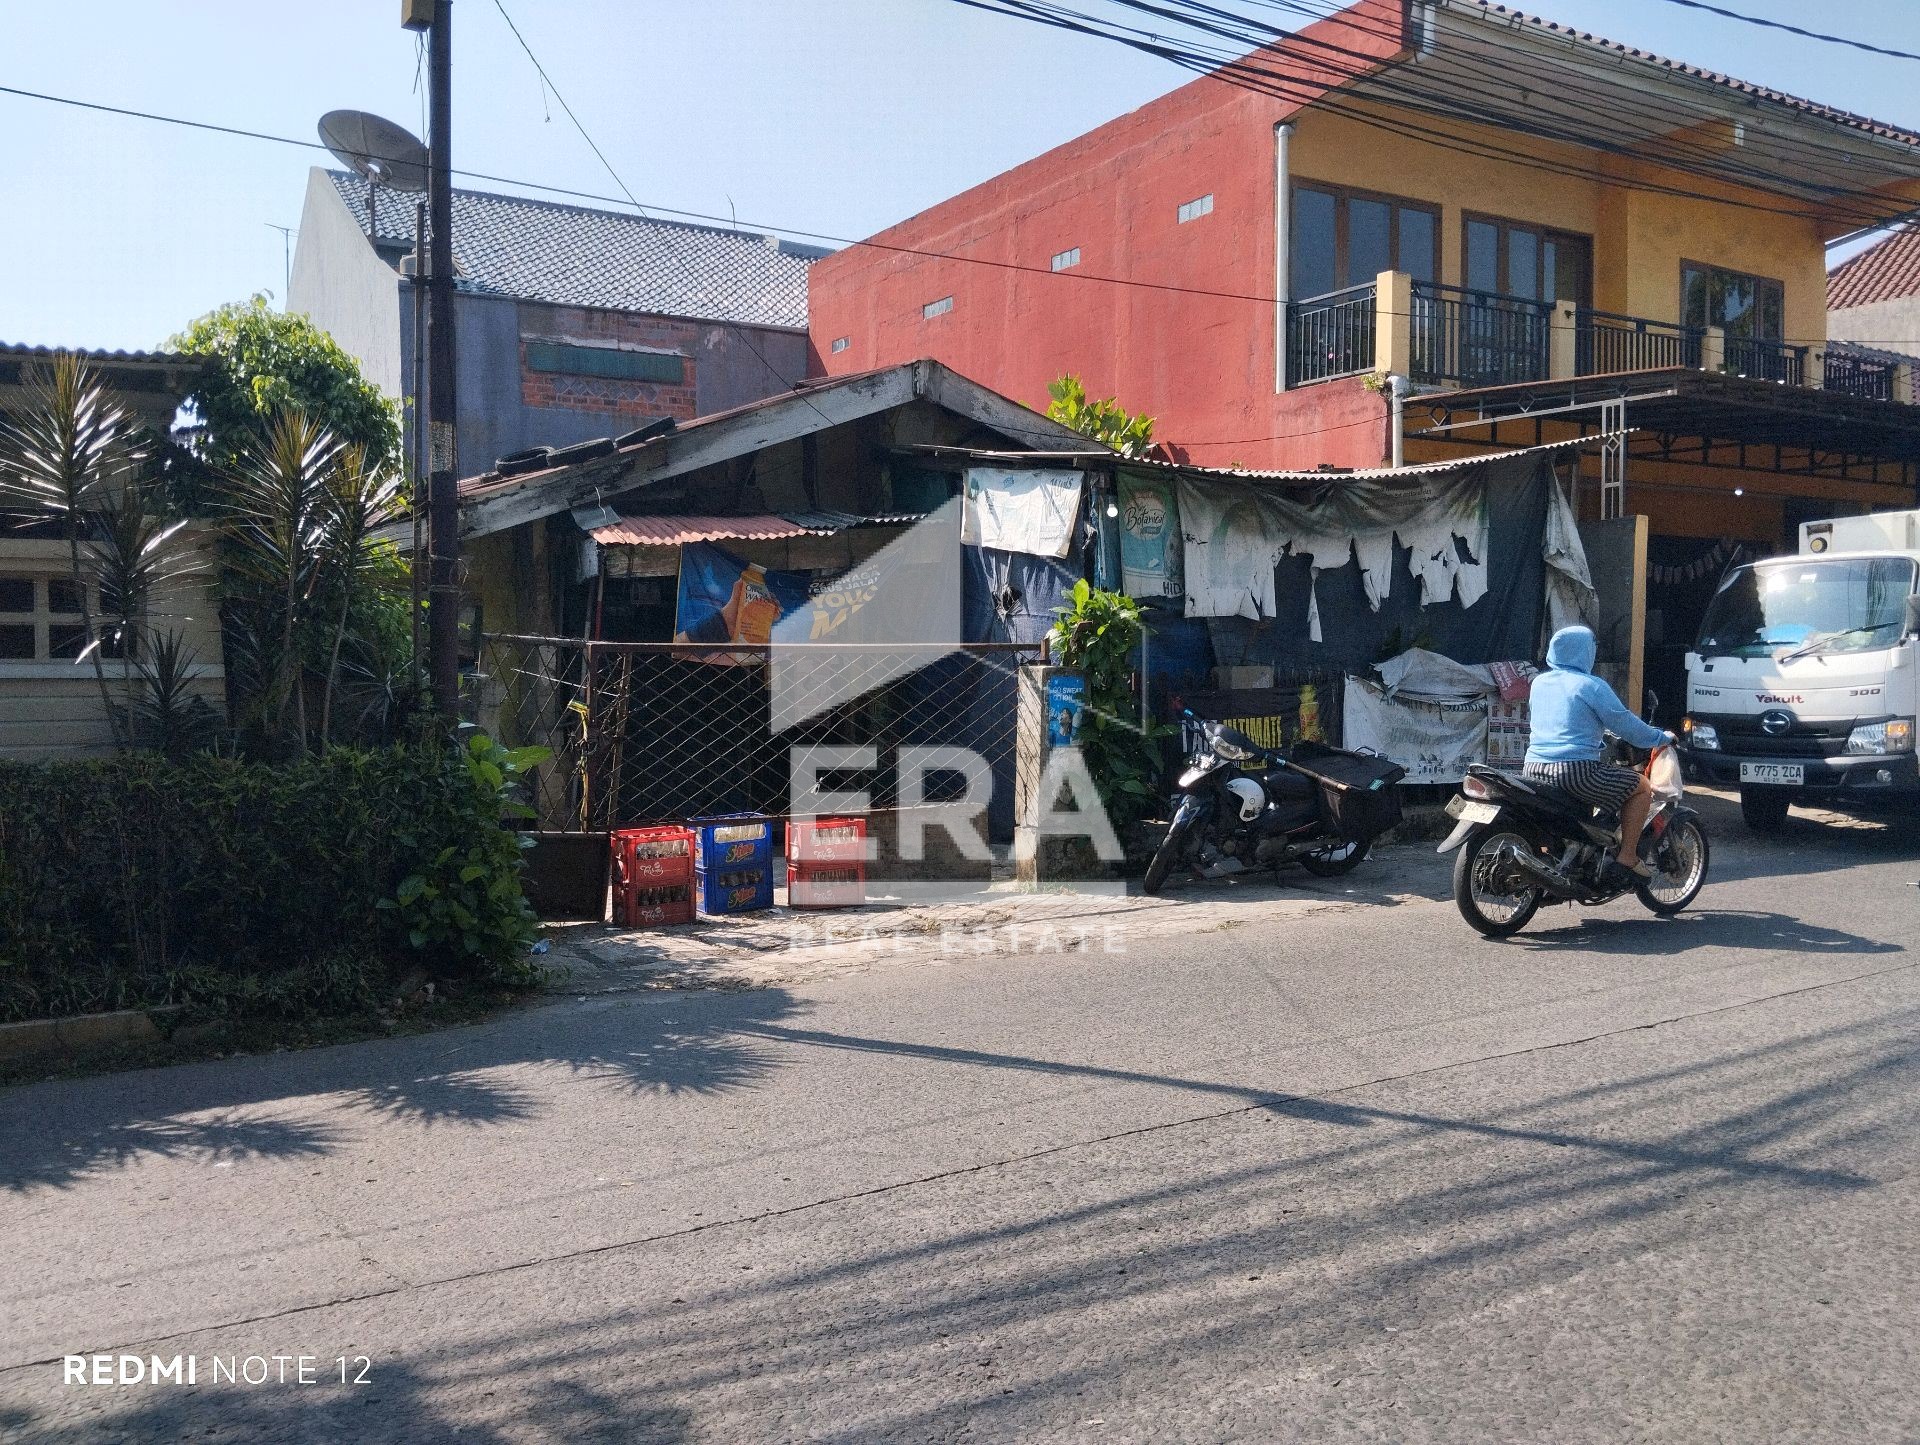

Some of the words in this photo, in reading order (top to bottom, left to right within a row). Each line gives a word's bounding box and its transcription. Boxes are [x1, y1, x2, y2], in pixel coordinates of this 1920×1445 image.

[1694, 689, 1720, 697] HINO
[1849, 688, 1881, 696] 300
[1755, 694, 1804, 704] Yakult
[1222, 716, 1282, 750] TIMATE
[1742, 764, 1748, 776] B
[1754, 765, 1778, 777] 9775
[1782, 765, 1802, 778] ZCA
